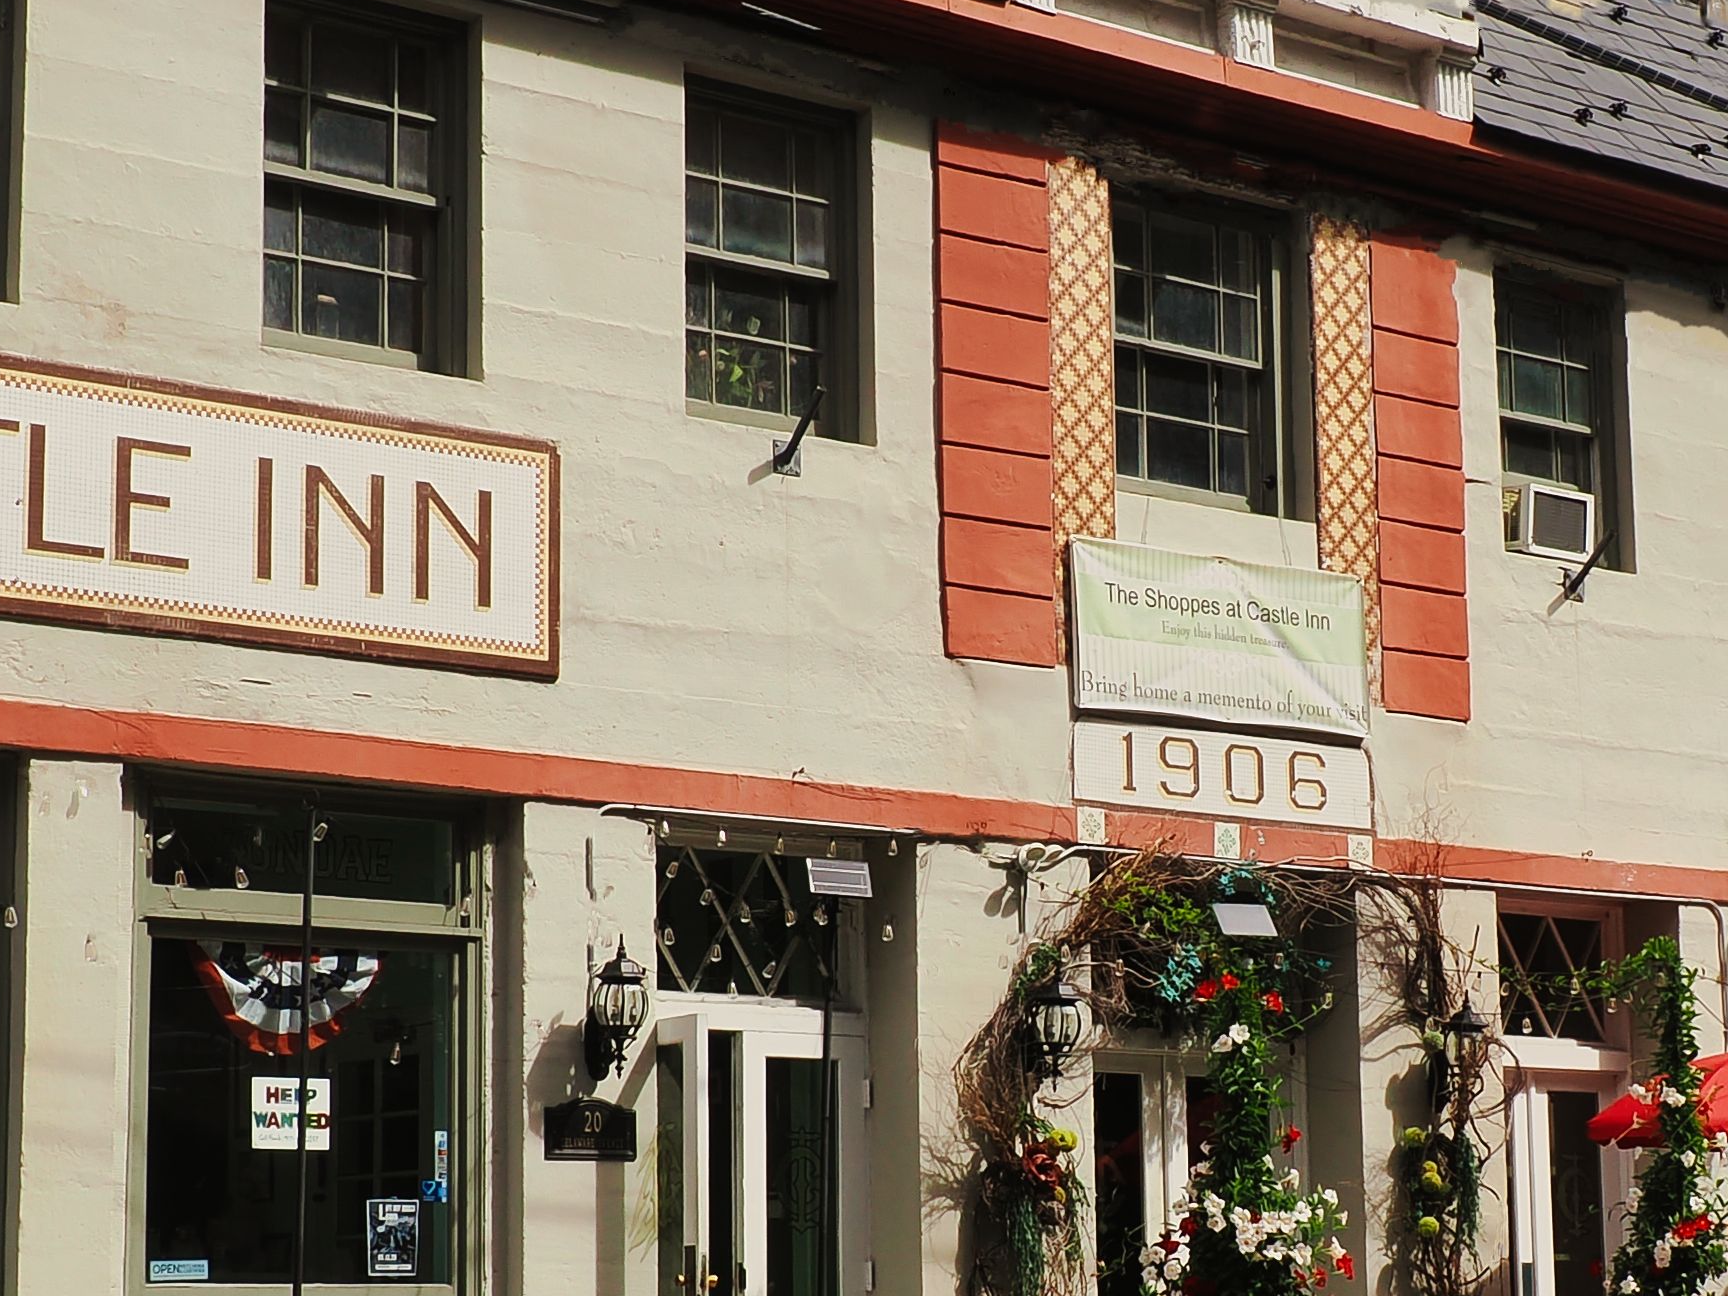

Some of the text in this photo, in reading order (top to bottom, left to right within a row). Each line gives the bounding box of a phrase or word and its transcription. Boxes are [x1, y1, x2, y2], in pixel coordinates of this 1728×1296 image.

[253, 456, 492, 612] INN
[1104, 582, 1331, 631] The Shoppes at Castle Inn
[1161, 620, 1191, 640] Enjoy
[1193, 622, 1212, 640] this
[1213, 624, 1247, 644] hidden
[1081, 670, 1368, 723] Bring home a memento of your visit
[1119, 731, 1328, 813] 1906
[223, 828, 393, 884] UNDAE
[253, 1110, 331, 1130] WANED
[583, 1110, 602, 1133] 20
[152, 1263, 180, 1275] OPEN
